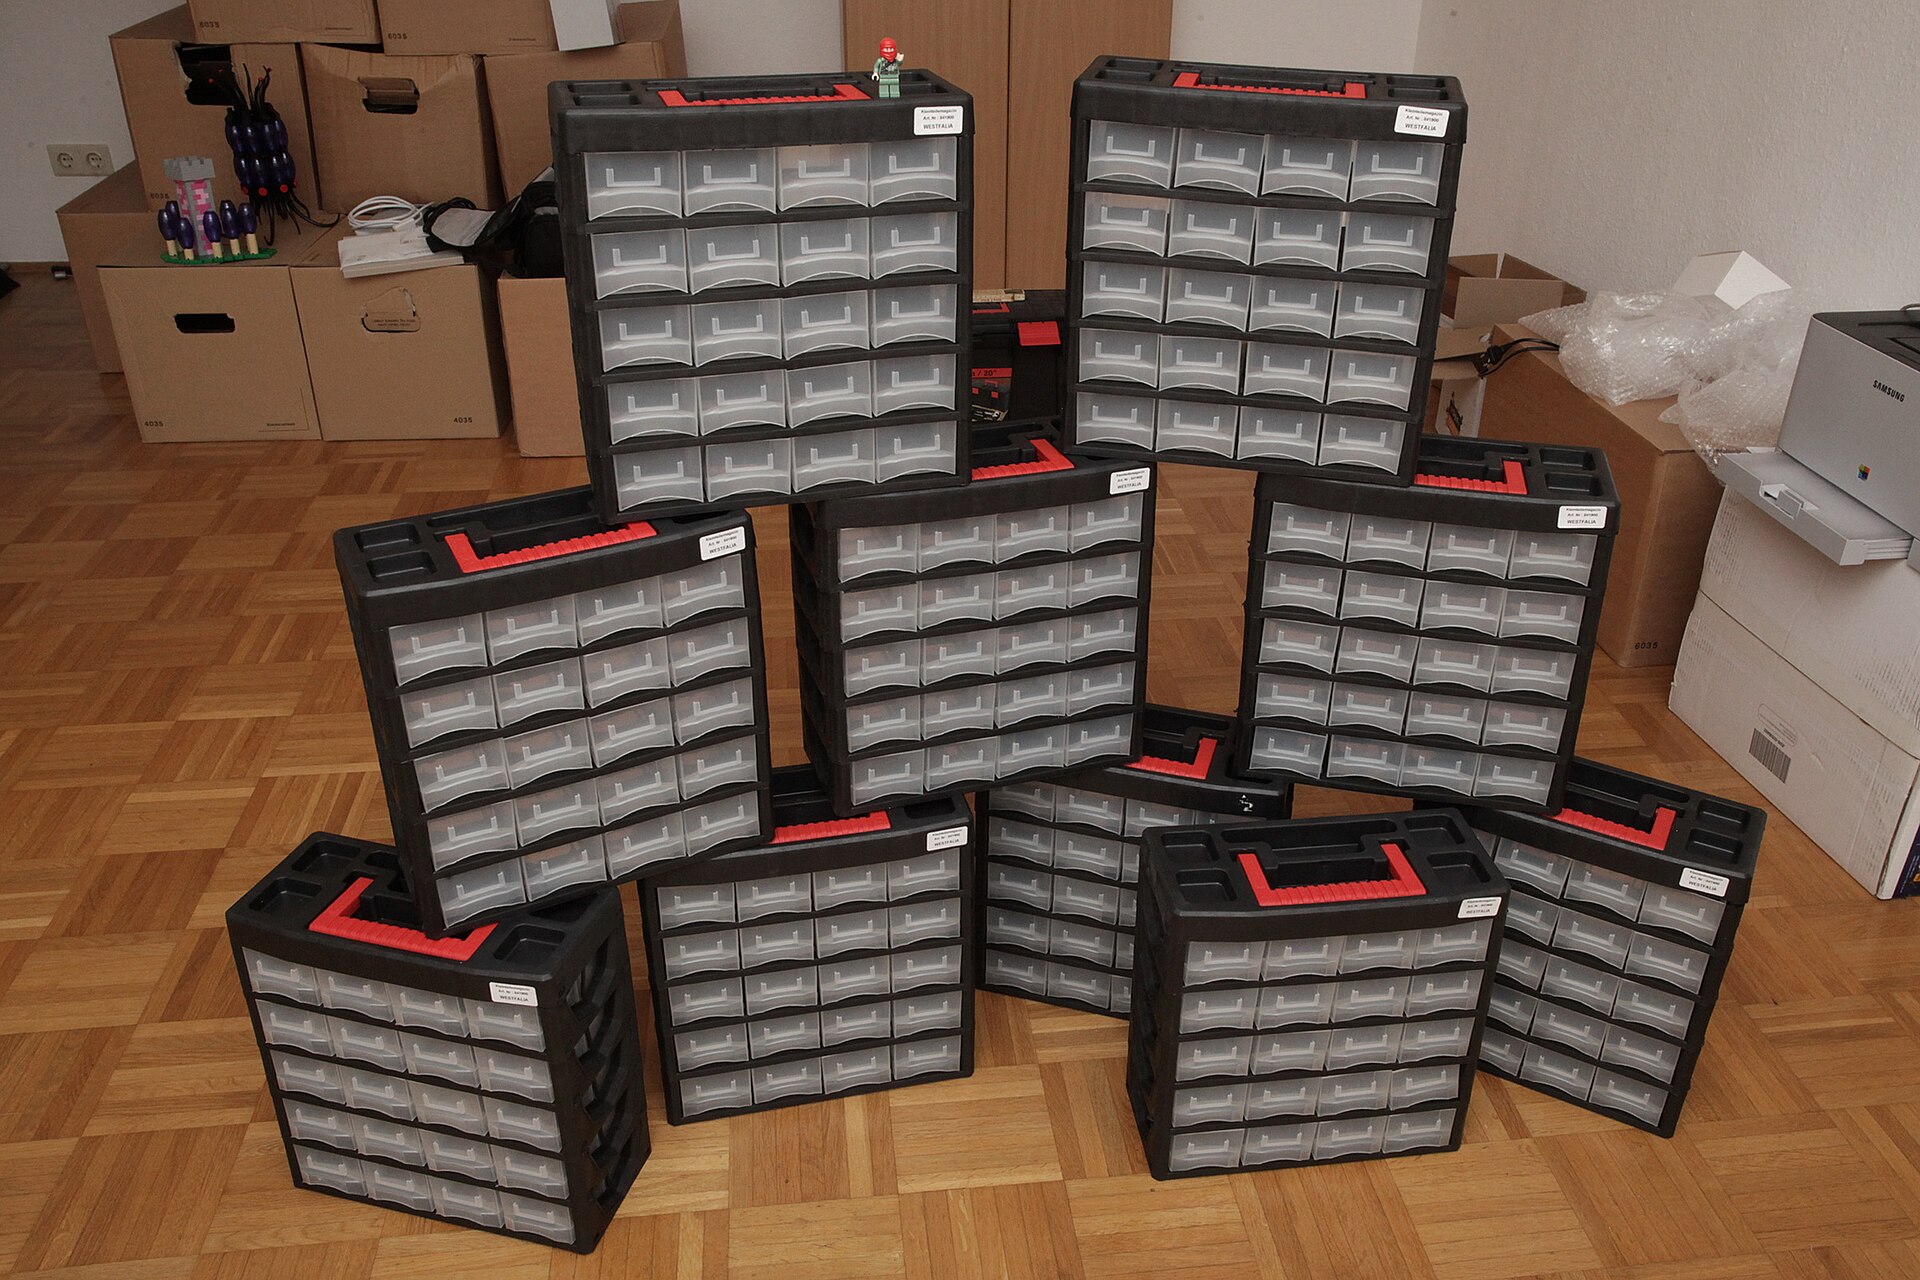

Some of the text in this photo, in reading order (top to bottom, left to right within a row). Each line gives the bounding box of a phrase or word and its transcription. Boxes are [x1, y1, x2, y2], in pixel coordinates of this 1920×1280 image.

[1404, 123, 1437, 131] WESTFALIA
[1872, 380, 1905, 402] SAMSUNG
[144, 420, 164, 428] 4035
[453, 416, 473, 424] 4035
[709, 543, 737, 554] WESTFALIA
[1635, 642, 1658, 650] 6035
[1688, 881, 1717, 891] WESTFALIA
